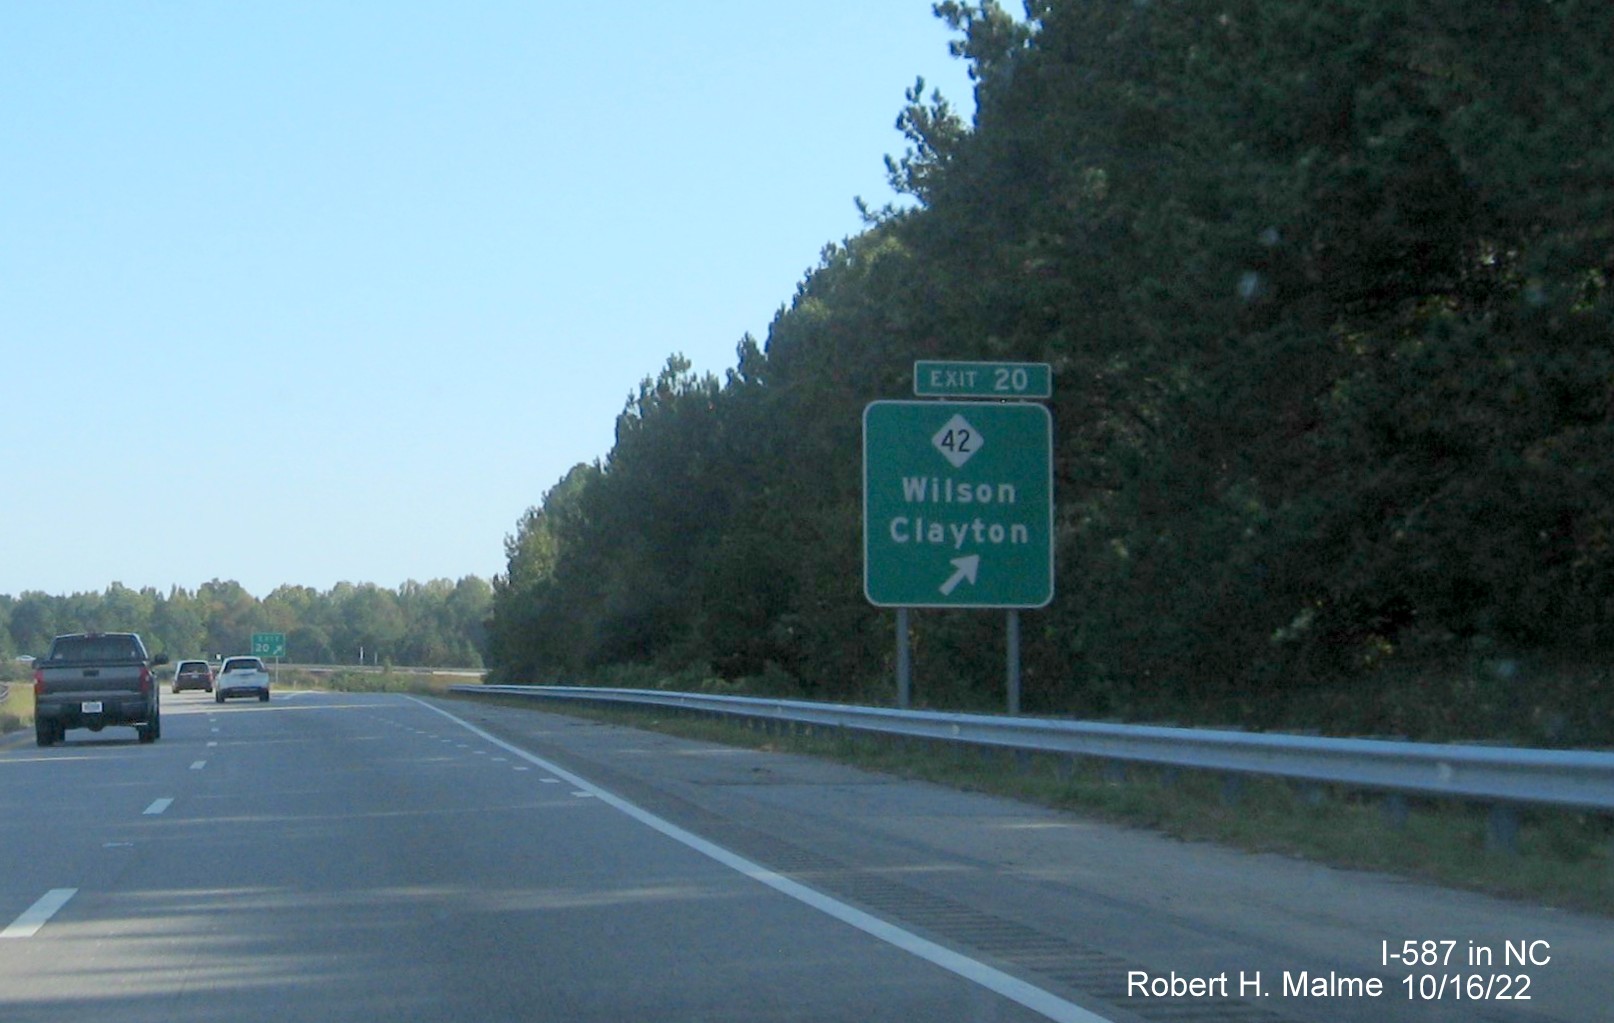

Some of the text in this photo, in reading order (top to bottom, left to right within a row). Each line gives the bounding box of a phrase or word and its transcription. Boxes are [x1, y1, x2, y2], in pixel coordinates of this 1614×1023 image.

[931, 369, 1028, 391] EXIT 20
[941, 429, 970, 452] 42
[902, 476, 1016, 503] Wilson
[890, 516, 1028, 549] Clayton
[255, 643, 270, 652] 20
